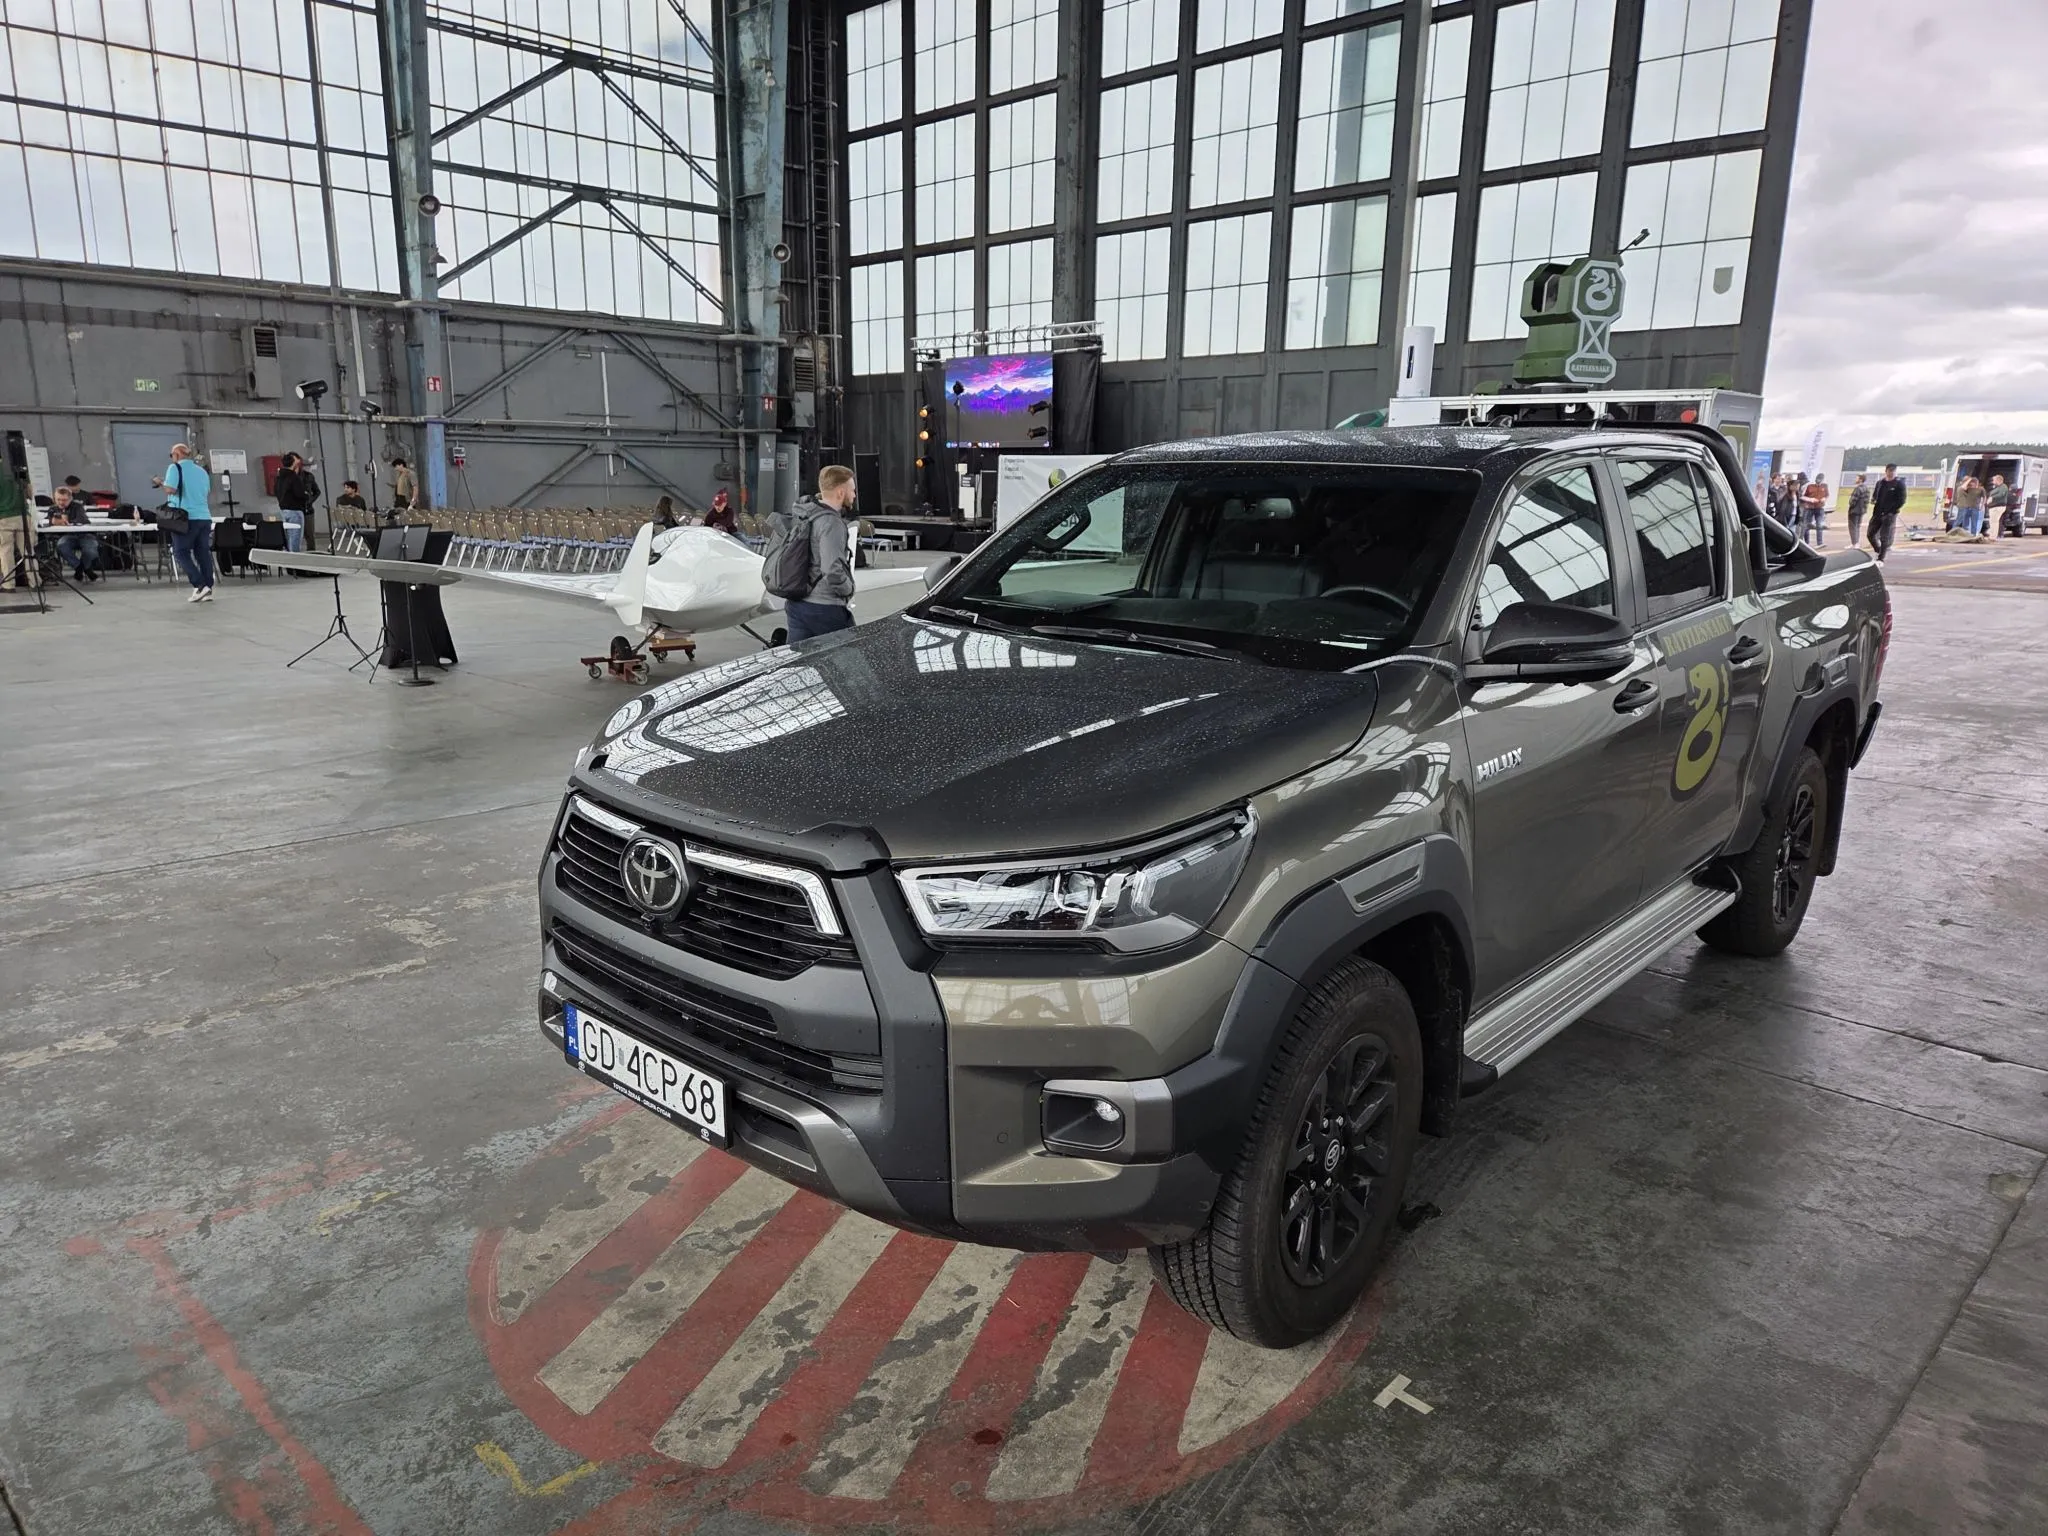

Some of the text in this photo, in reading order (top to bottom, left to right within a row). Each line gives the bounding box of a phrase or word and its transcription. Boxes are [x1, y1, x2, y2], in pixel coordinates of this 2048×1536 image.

[1571, 364, 1610, 373] RATTLESNAKE
[1663, 614, 1732, 656] RATTLESNAKE
[1476, 747, 1522, 782] HILUX
[568, 1036, 578, 1050] PL
[583, 1021, 716, 1125] GD 4CP68
[613, 1082, 628, 1095] TOYOTA
